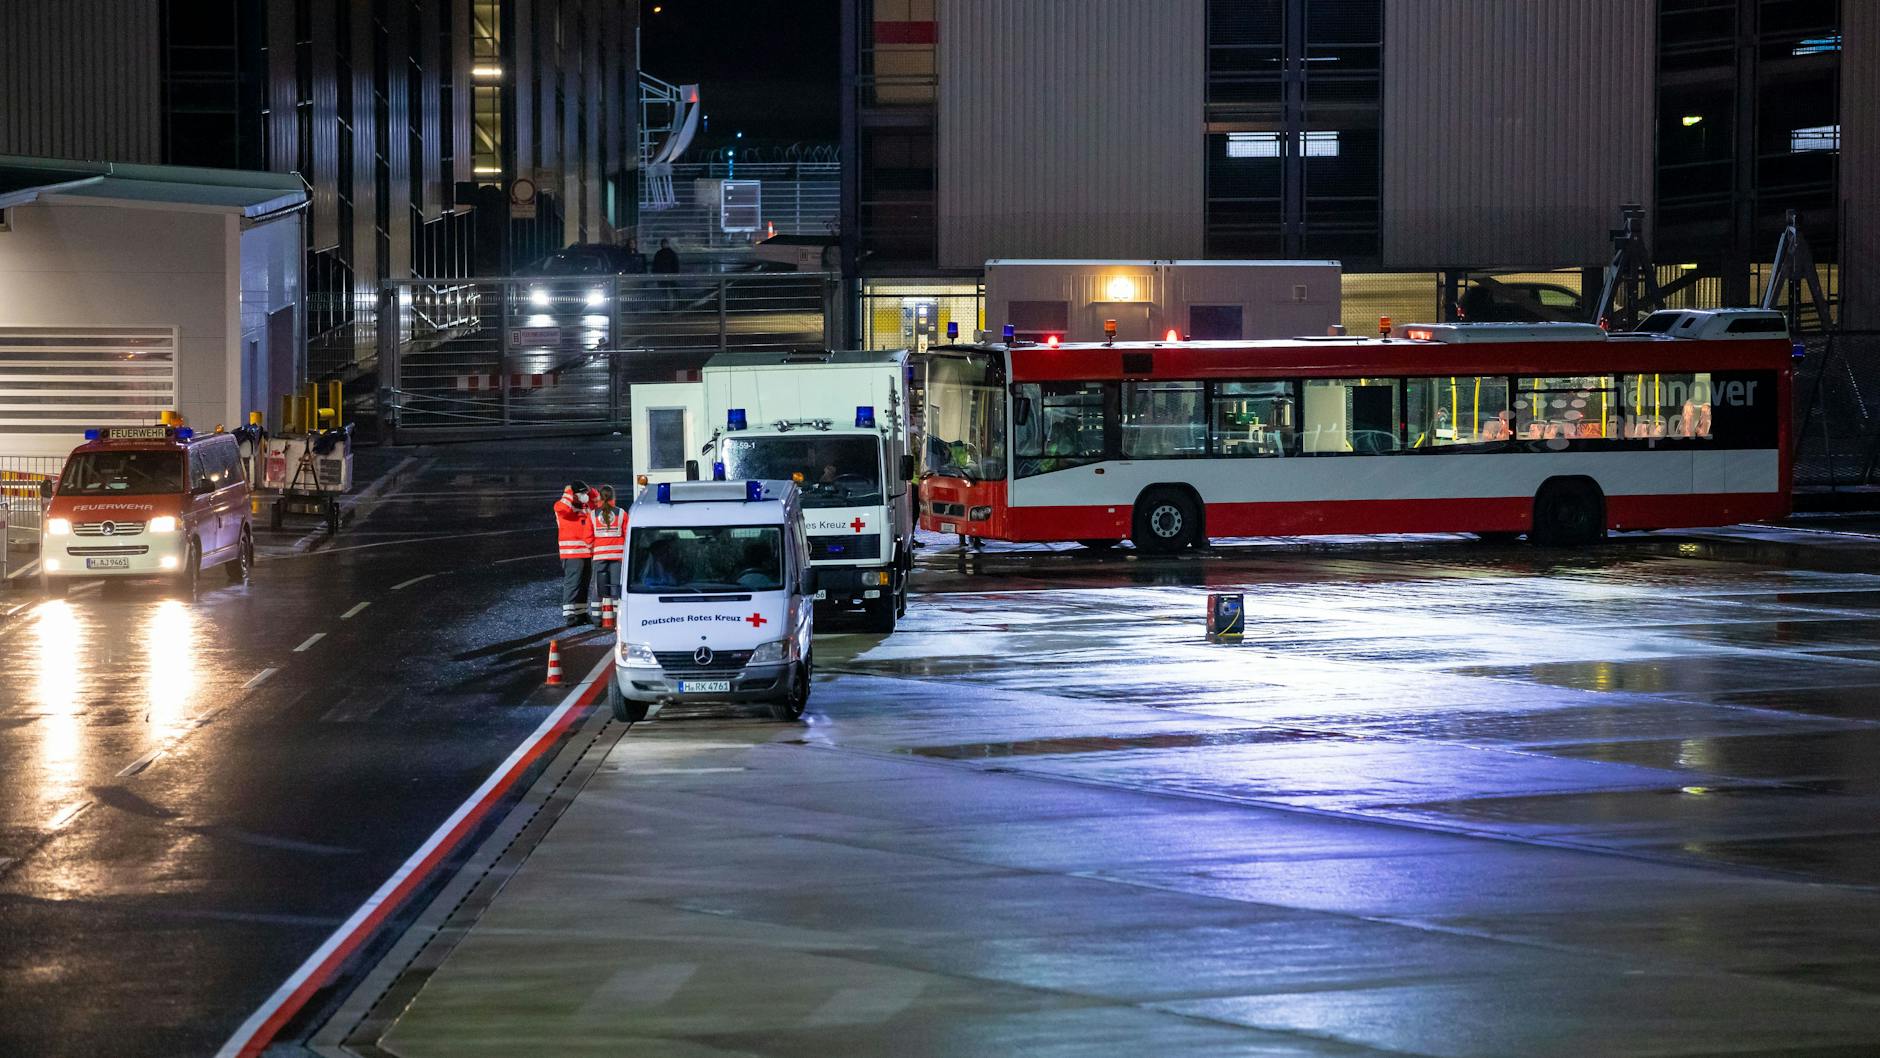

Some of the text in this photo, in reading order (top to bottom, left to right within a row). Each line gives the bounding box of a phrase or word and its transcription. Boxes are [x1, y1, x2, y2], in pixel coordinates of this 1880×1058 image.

[1607, 374, 1757, 407] hannover
[111, 428, 164, 438] FEUERWEHR
[72, 503, 154, 512] FEUERWEHR
[819, 520, 847, 529] Kreuz
[641, 614, 741, 627] Deutsches Rotes Kreuz
